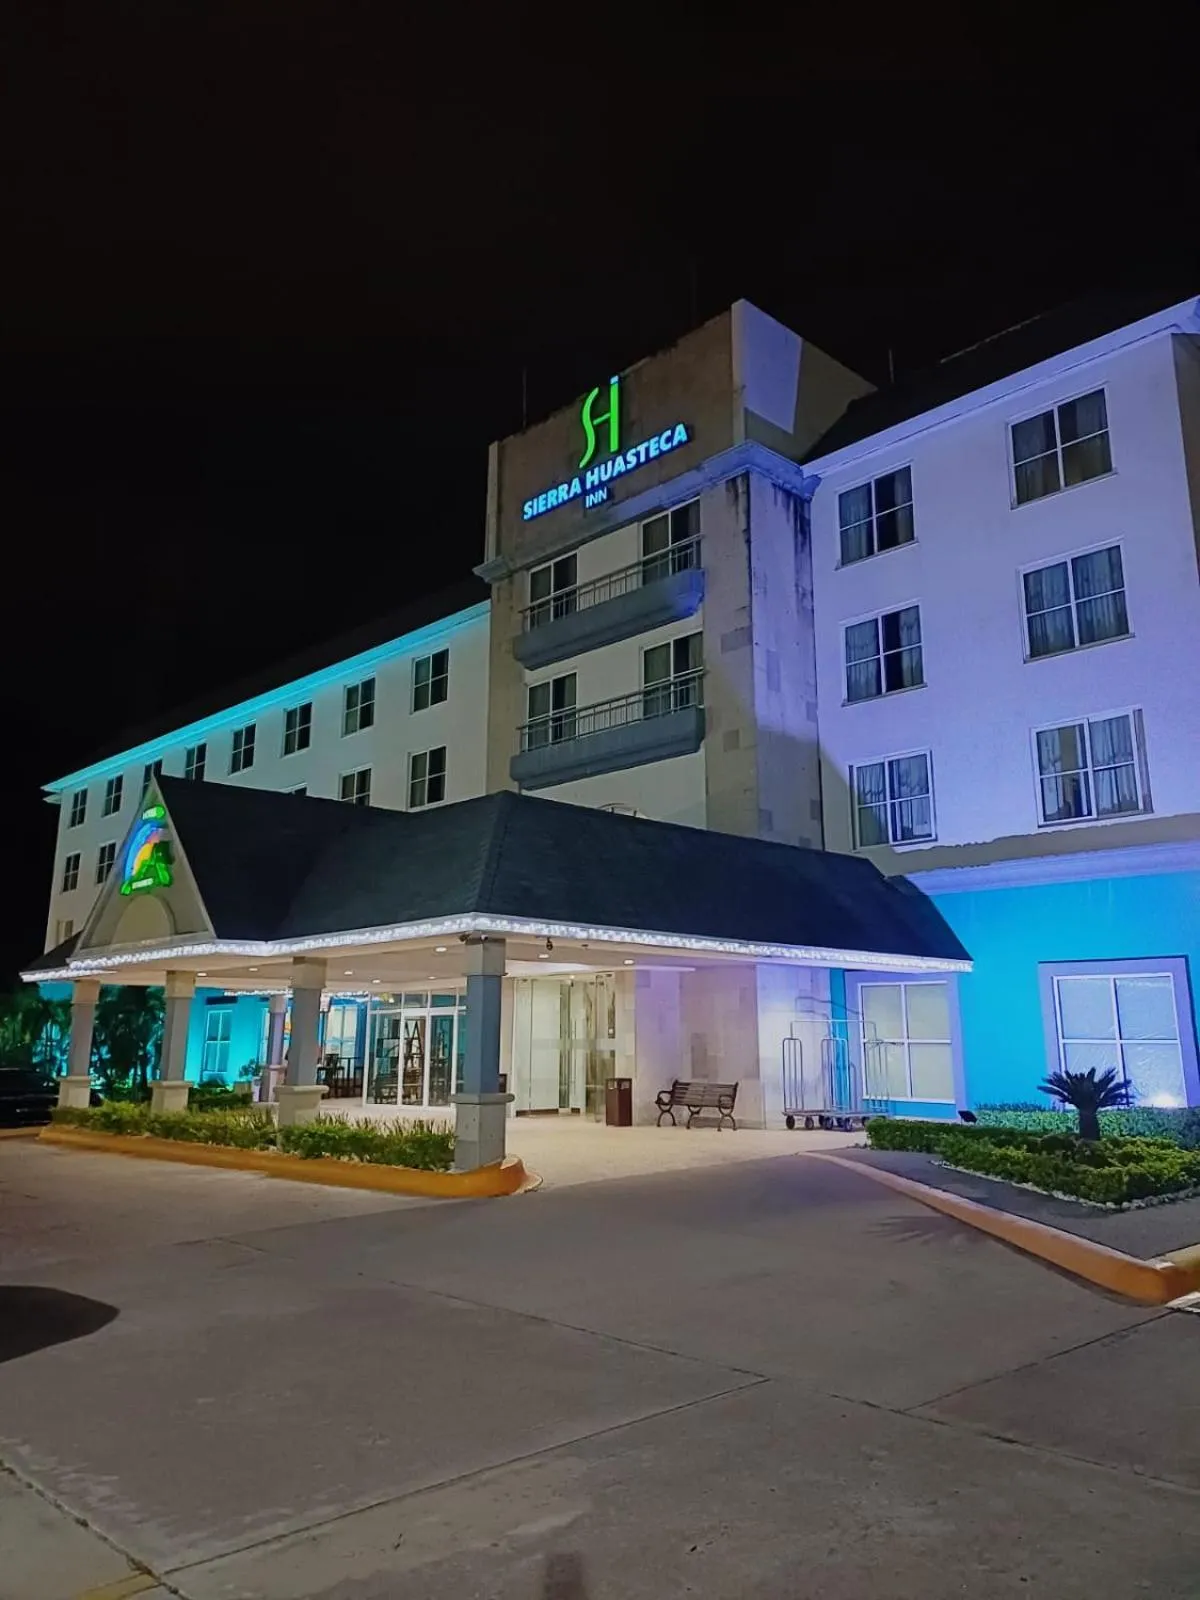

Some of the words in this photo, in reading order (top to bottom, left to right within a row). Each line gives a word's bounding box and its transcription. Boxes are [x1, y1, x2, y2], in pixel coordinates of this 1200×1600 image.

[522, 477, 581, 520] SIERRA
[585, 423, 688, 490] HUASTECA
[585, 487, 608, 508] INN
